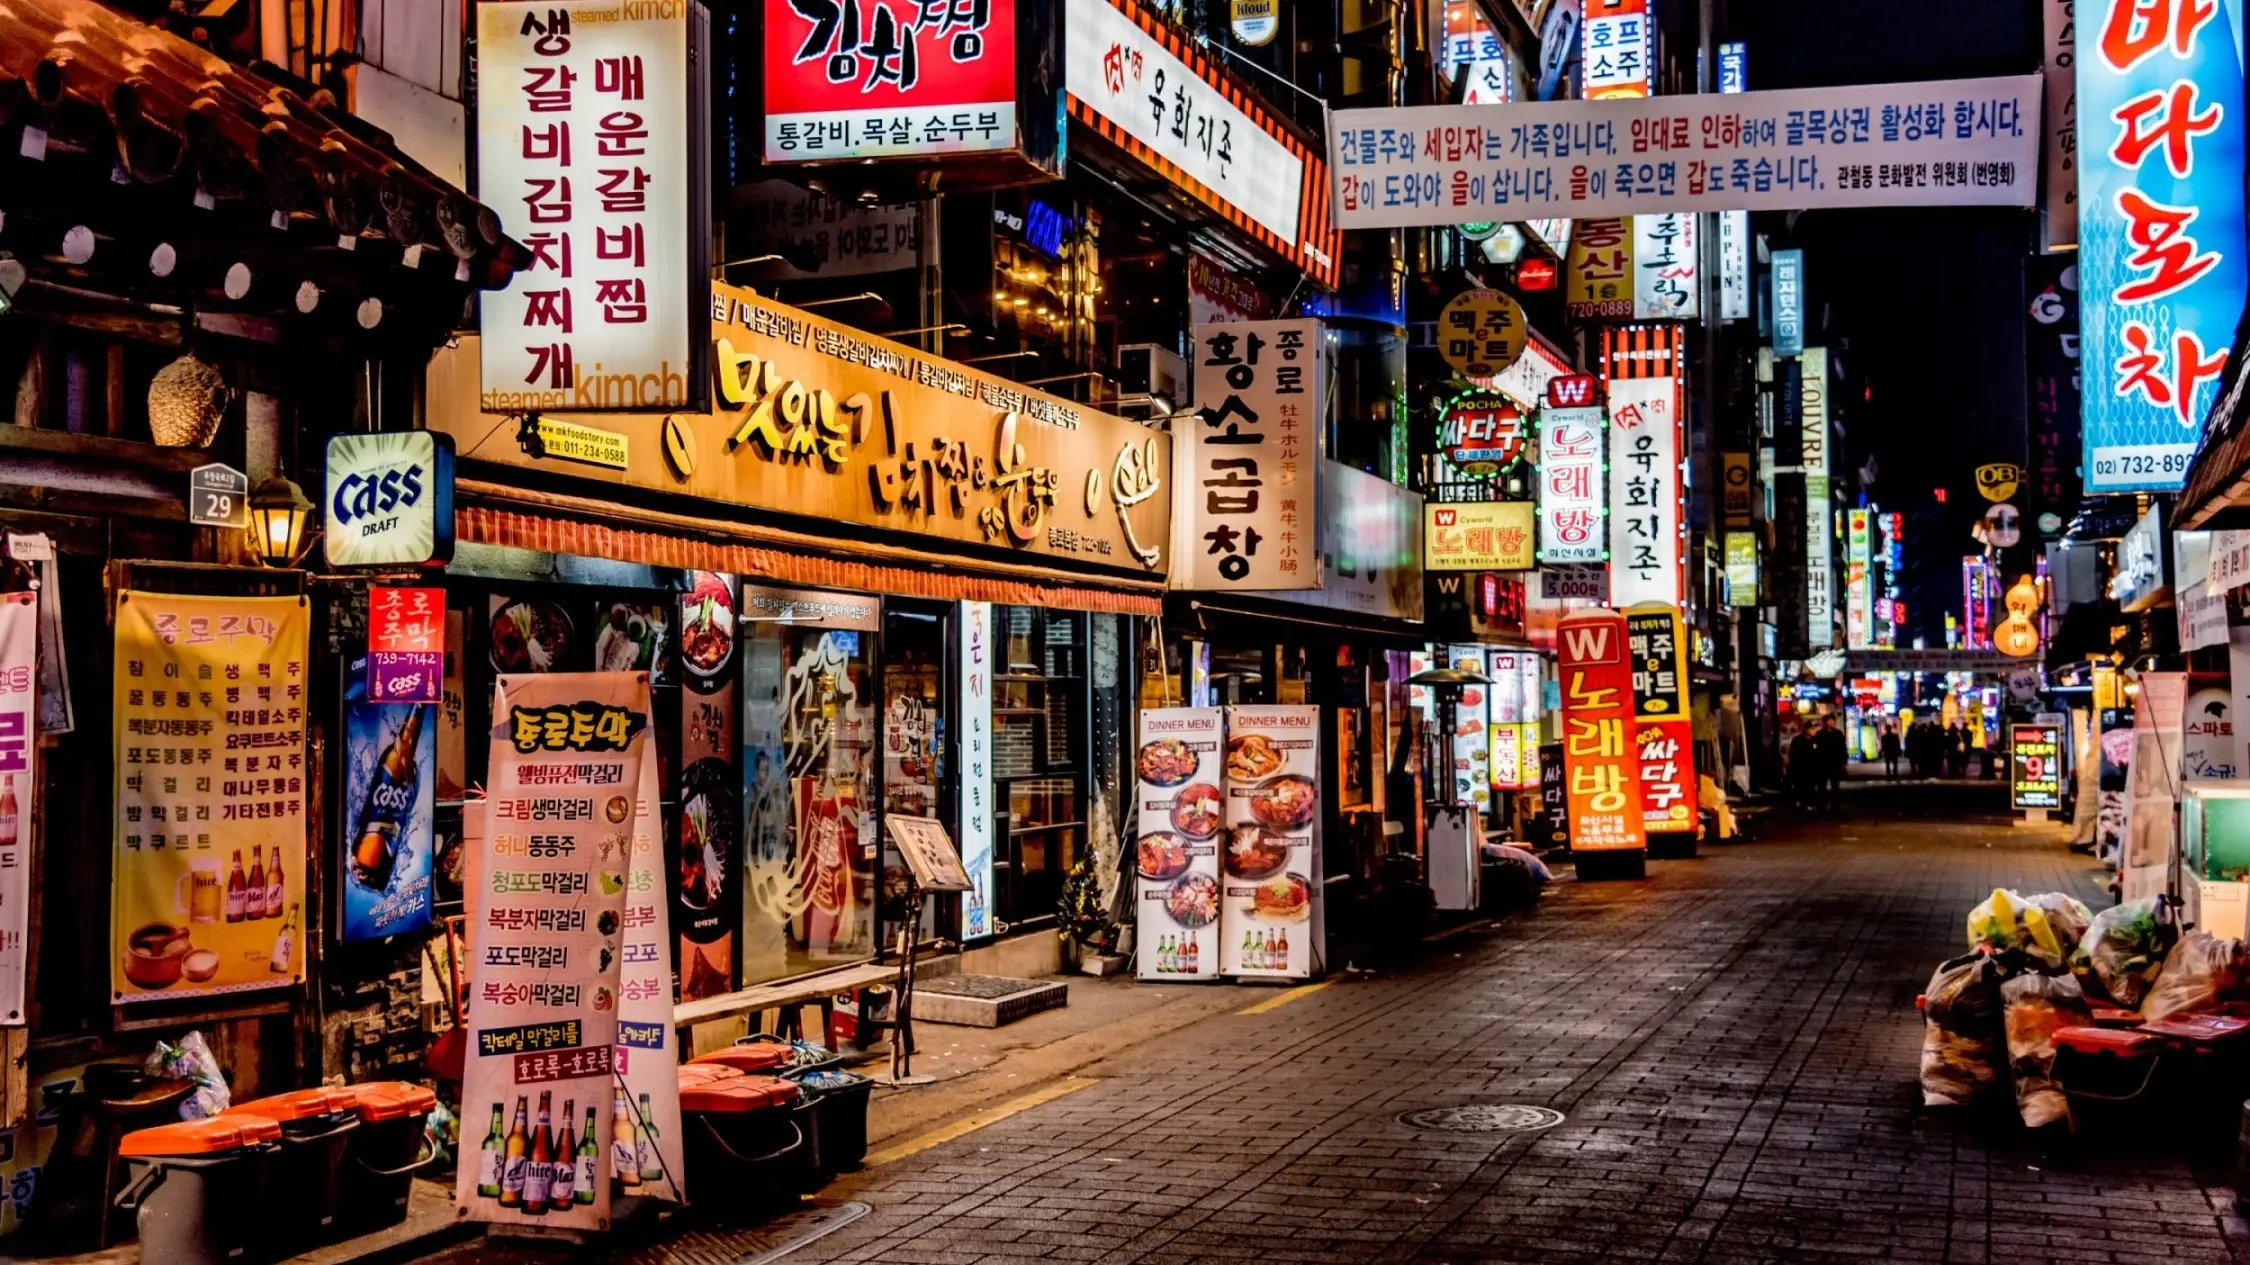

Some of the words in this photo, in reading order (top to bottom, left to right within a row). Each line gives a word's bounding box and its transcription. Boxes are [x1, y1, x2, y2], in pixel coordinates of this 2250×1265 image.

[571, 8, 619, 23] steamed
[623, 0, 685, 21] kimch
[1591, 20, 1641, 49] 호프
[1591, 50, 1641, 80] 소주
[776, 111, 1000, 151] 통갈비.목살.순두부
[1149, 69, 1232, 180] 육회지존
[1340, 128, 1416, 165] 건물주와
[1424, 125, 1502, 162] 세입자는
[1510, 120, 1618, 159] 가족입니다.
[1630, 116, 1691, 152] 임대료
[1701, 112, 1776, 149] 인하하여
[1785, 106, 1871, 146] 골목상권
[1881, 102, 1946, 142] 활성화
[1954, 98, 2024, 139] 합시다.
[594, 54, 652, 325] 매운갈비찜
[1342, 174, 1376, 211] 갑이
[1383, 170, 1442, 209] 도와야
[1450, 170, 1486, 206] 을이
[1492, 167, 1560, 204] 삽니다.
[1569, 164, 1606, 201] 을이
[1614, 161, 1676, 198] 죽으면
[1686, 160, 1725, 196] 갑도
[1730, 155, 1825, 193] 죽습니다.
[1837, 164, 1874, 189] 관철동
[1878, 163, 1927, 188] 문화발전
[1932, 161, 1969, 187] 위원회
[1971, 160, 2016, 187] (번영회)
[520, 9, 577, 390] 생갈비김치찌개
[2100, 0, 2230, 424] 바다포차
[742, 303, 803, 345] 매운갈비찜
[1448, 310, 1513, 335] 맥주
[1570, 301, 1634, 319] 720-0889
[1275, 330, 1304, 395] 종로
[1448, 340, 1512, 363] 마트
[481, 388, 566, 411] steamed
[713, 337, 851, 465] 맛있는
[1554, 380, 1586, 402] W
[1457, 401, 1502, 410] POCHA
[541, 424, 621, 448] ww.mkfoodstory.com
[1441, 413, 1523, 451] 싸다구
[1801, 376, 1823, 470] LOUVRE
[1203, 331, 1267, 581] 황소곱창
[2121, 456, 2195, 475] 732-89
[1546, 425, 1598, 545] 노래방
[1980, 467, 2014, 483] OB
[206, 494, 231, 518] 29
[333, 463, 424, 526] Cass
[1625, 436, 1662, 581] 육회지존
[362, 517, 399, 537] DRAFT
[1437, 511, 1454, 525] W
[1432, 526, 1526, 556] 노래방
[1438, 578, 1459, 594] W
[376, 590, 433, 620] 종로
[154, 613, 278, 646] 종로주막
[378, 619, 437, 649] 주막
[375, 651, 437, 665] 739-7142
[1565, 627, 1608, 662] W
[1629, 634, 1674, 660] 맥주
[1499, 659, 1512, 668] W
[1647, 658, 1660, 671] e
[1632, 671, 1677, 697] 마트
[1148, 720, 1185, 731] DINNER
[1187, 719, 1216, 729] MENU
[1238, 716, 1277, 726] DINNER
[1280, 715, 1311, 726] MENU
[1567, 671, 1629, 813] 노래방
[517, 763, 624, 785] 웰빙퓨전막걸리
[1640, 738, 1684, 808] 싸다구
[2025, 756, 2043, 781] 9
[223, 800, 301, 820] 기타전통주
[496, 797, 594, 821] 크림생막걸리
[494, 833, 576, 859] 허니동동주
[491, 869, 589, 896] 청포도막걸리
[487, 906, 587, 933] 복분자막걸리
[483, 943, 568, 971] 포도막걸리
[482, 981, 581, 1009] 복숭아막걸리
[481, 1028, 525, 1053] 칵테일
[527, 1021, 579, 1048] 막걸리를
[518, 1047, 610, 1082] 호로록-호로록
